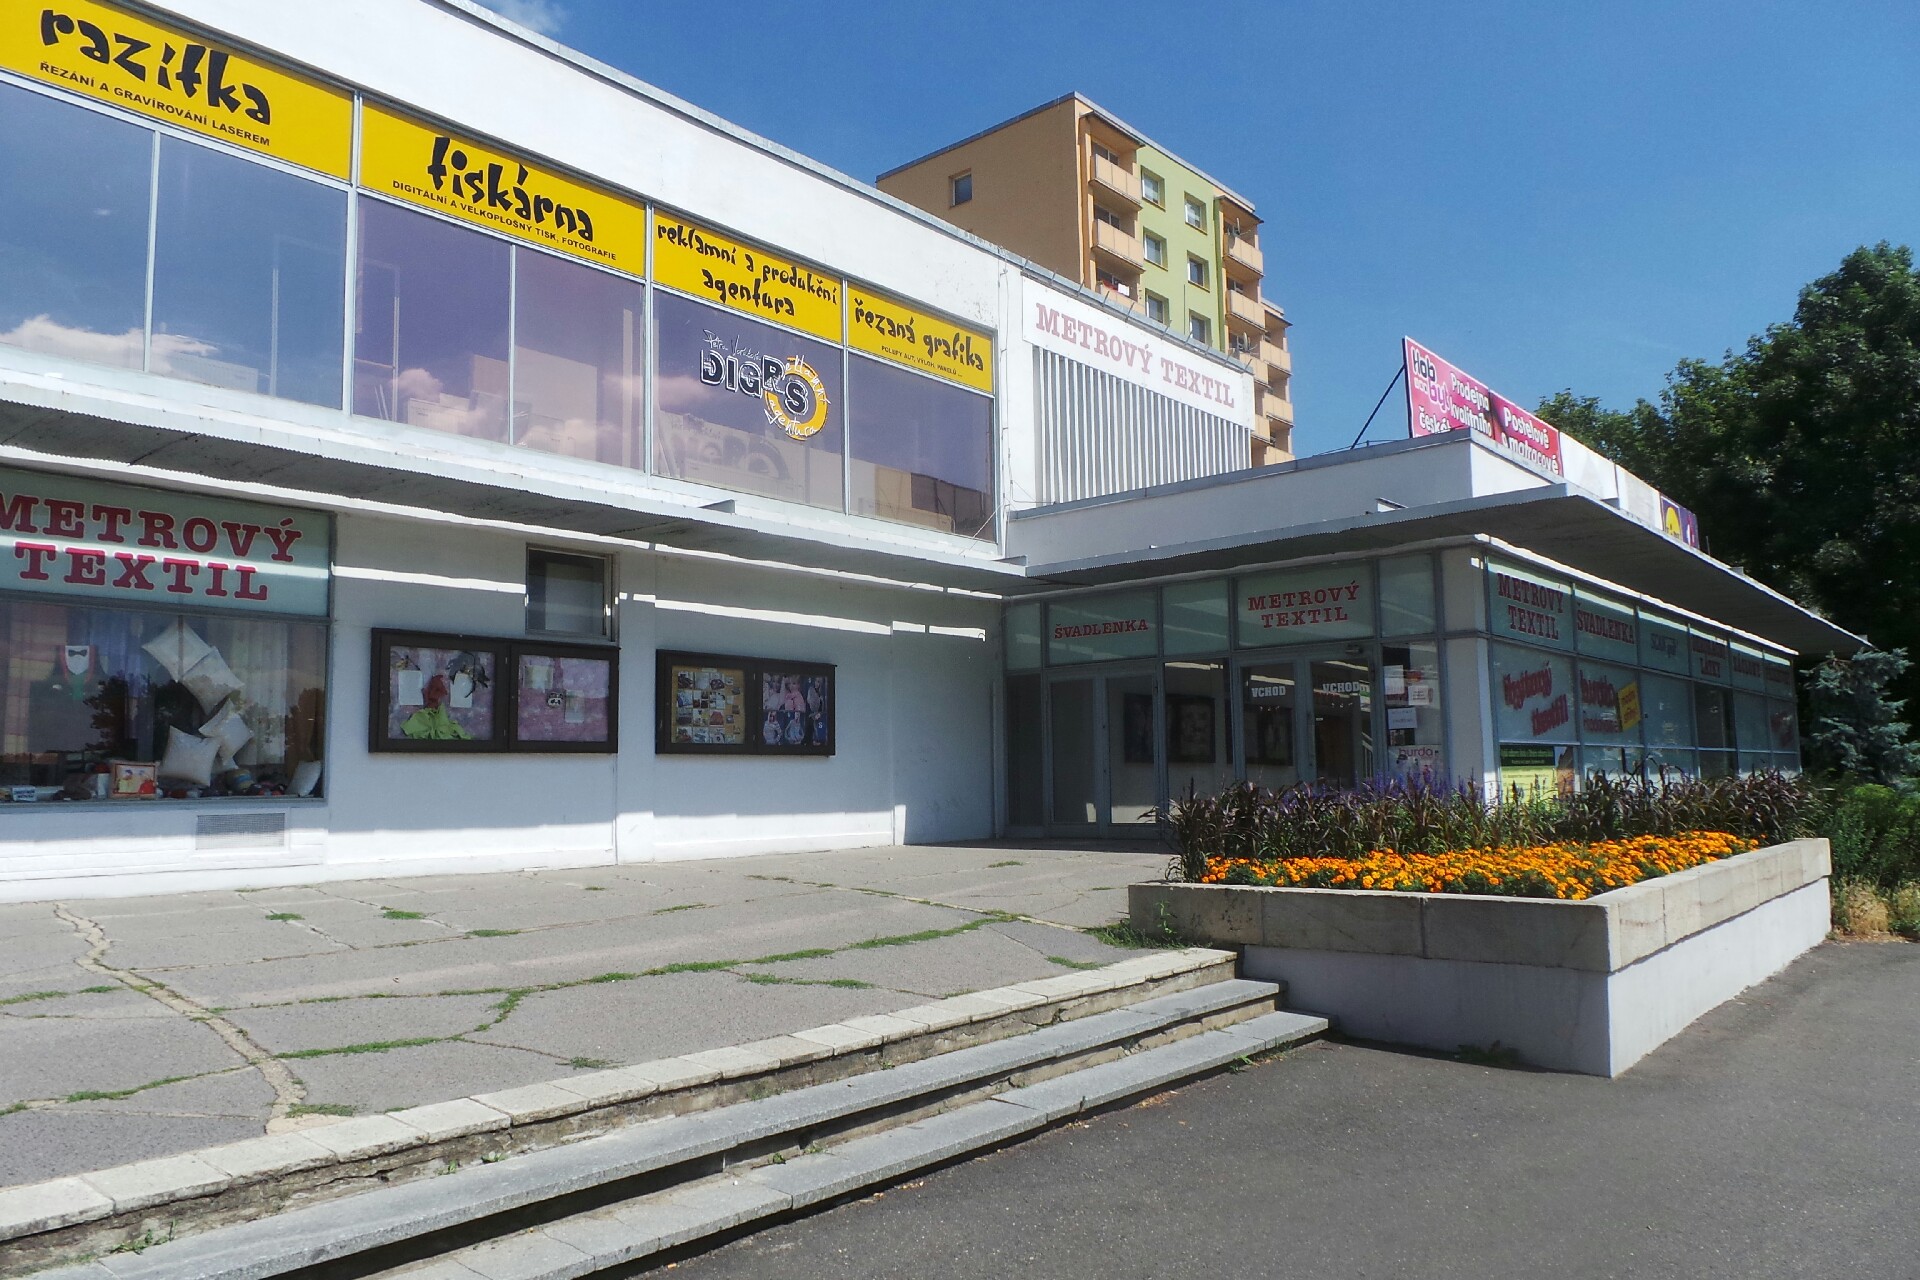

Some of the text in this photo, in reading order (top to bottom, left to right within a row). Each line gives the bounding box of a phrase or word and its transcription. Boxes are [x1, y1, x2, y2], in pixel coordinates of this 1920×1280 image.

[41, 10, 271, 126] razítka
[39, 60, 271, 147] ŘEZÁNÍ A GRAVÍROVÁNÍ LASEREM
[427, 136, 594, 242] tiskárna
[392, 179, 448, 205] DIGITÁLNÍ
[450, 199, 459, 209] A
[534, 227, 560, 244] TISK,
[561, 236, 617, 261] FOTOGRAFIE
[657, 223, 838, 306] reklamní a produkční
[701, 268, 796, 317] agentura
[853, 297, 984, 372] řezaná grafika
[1035, 302, 1235, 409] METROVÝ TEXTIL
[1450, 371, 1490, 412] Prodejna
[1503, 406, 1550, 449] Postelové
[1509, 436, 1560, 476] matracové
[0, 490, 303, 563] METROVÝ
[14, 541, 269, 601] TEXTIL
[1247, 580, 1360, 611] METROVÝ
[1497, 572, 1564, 614] METROVÝ
[1054, 618, 1149, 640] ŠVADLENKA
[1261, 606, 1348, 629] TEXTIL
[1507, 604, 1559, 641] TEXTIL
[1576, 602, 1636, 645] ŠVADLENKA
[1251, 685, 1287, 698] VCHOD
[1322, 681, 1361, 694] VCHOD
